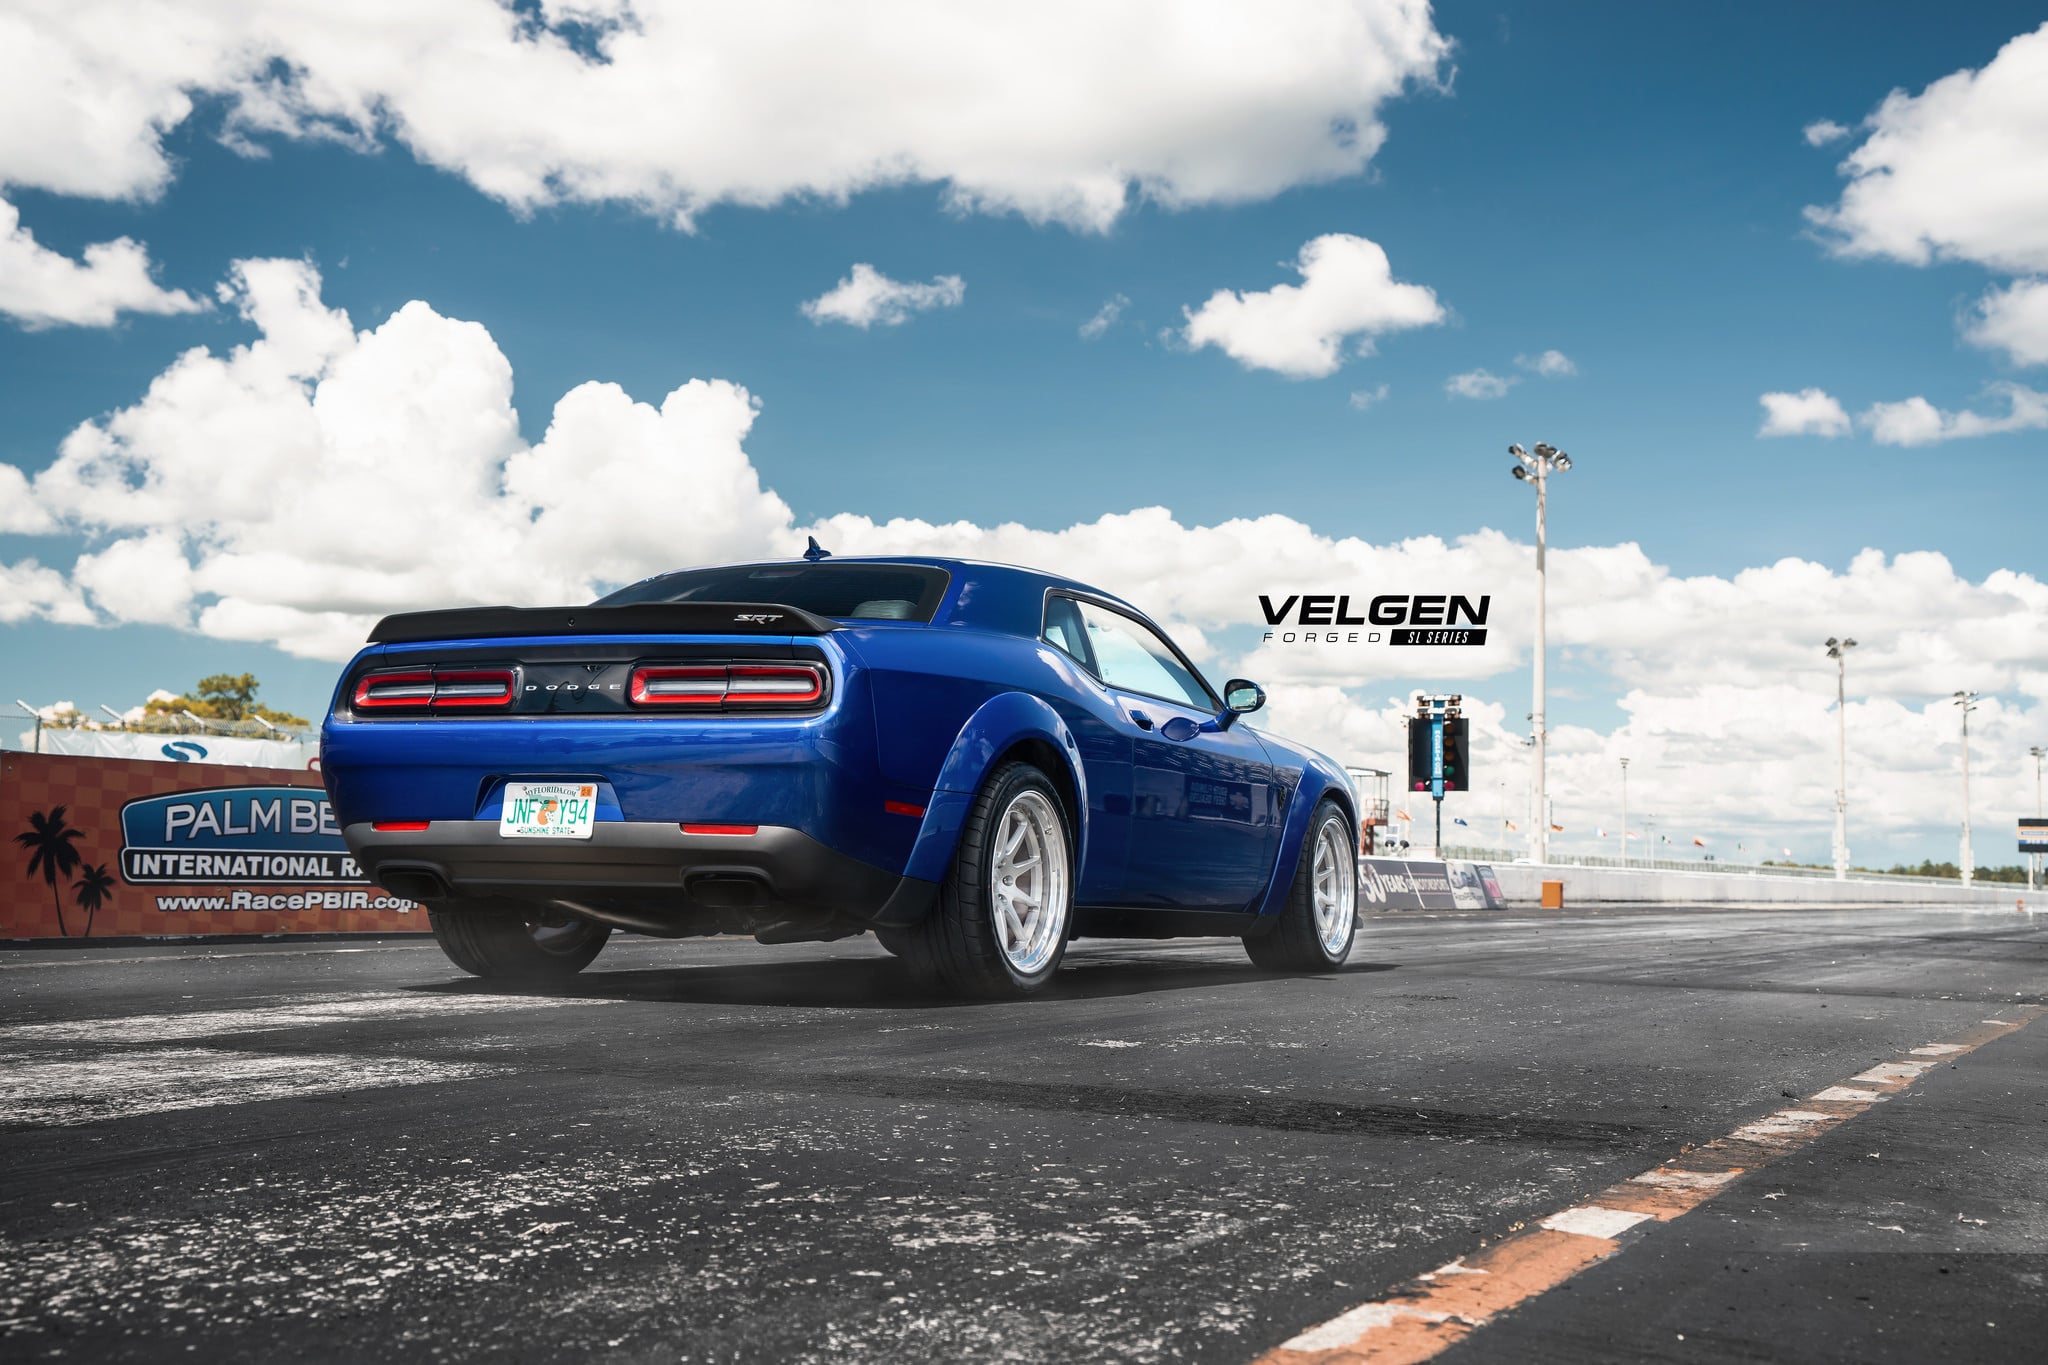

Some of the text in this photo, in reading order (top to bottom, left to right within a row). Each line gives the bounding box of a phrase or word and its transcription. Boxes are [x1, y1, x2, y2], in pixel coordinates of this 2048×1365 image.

[733, 614, 784, 625] SRT
[525, 683, 622, 691] DODGE
[165, 799, 281, 842] PALM
[506, 799, 589, 825] JNF Y94
[520, 826, 571, 835] SUNSHINE STATE
[132, 854, 334, 877] INTERNATIONAL
[1379, 874, 1409, 893] YEARS
